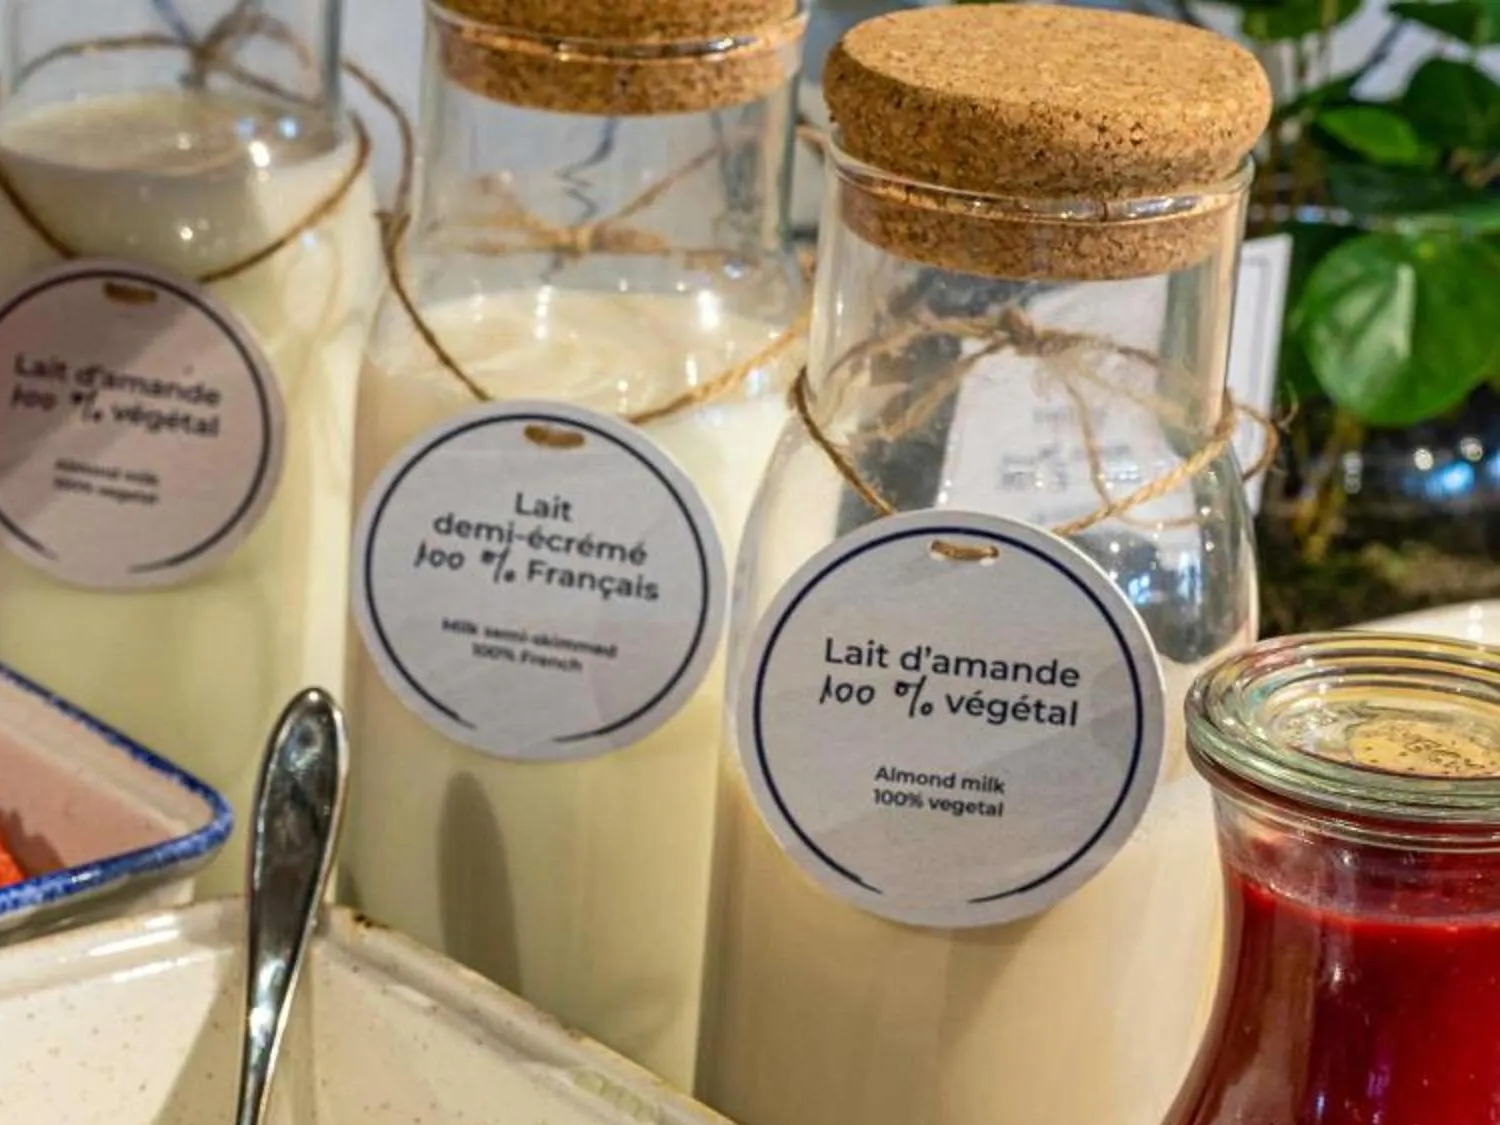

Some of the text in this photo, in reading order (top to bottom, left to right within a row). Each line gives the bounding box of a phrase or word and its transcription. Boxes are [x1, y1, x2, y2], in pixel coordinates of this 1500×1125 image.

[14, 352, 67, 383] Lait
[111, 402, 220, 438] végétal
[515, 492, 572, 522] Lait
[432, 512, 648, 567] demi-écrémé
[481, 545, 517, 584] %
[527, 558, 659, 601] Français
[824, 637, 888, 669] Lait
[819, 674, 1079, 728] 100 % végétal
[874, 766, 1005, 795] Almond milk
[873, 788, 1004, 818] 100% vegetal
